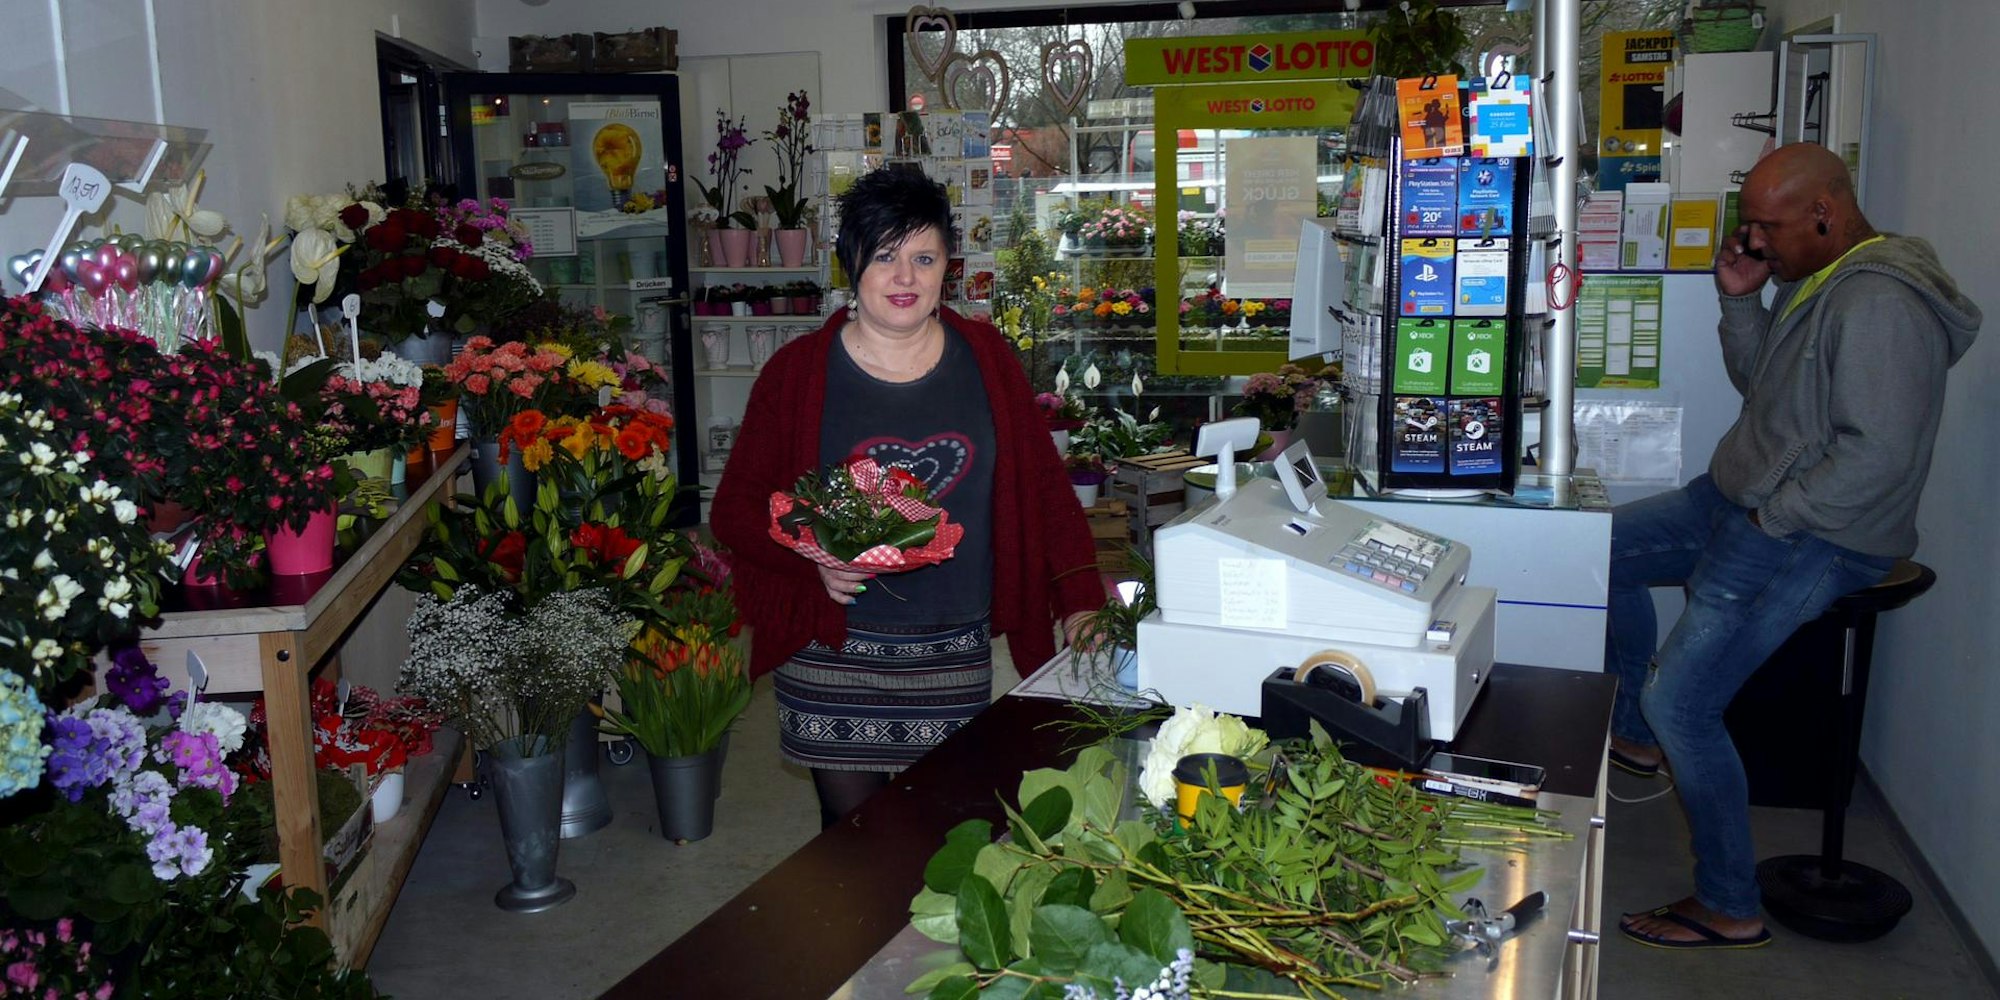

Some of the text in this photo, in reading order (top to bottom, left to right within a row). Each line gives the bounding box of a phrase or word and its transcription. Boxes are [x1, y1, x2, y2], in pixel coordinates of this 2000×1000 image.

[1625, 37, 1675, 50] JACKPOT
[1162, 40, 1375, 75] WEST LOTTO
[1631, 52, 1668, 62] SAMSTAG
[1622, 72, 1655, 81] LOTTO
[1207, 97, 1316, 114] WEST LOTTO
[636, 280, 667, 288] Drücken
[1404, 433, 1438, 443] STEAM
[1456, 442, 1493, 452] STEAM
